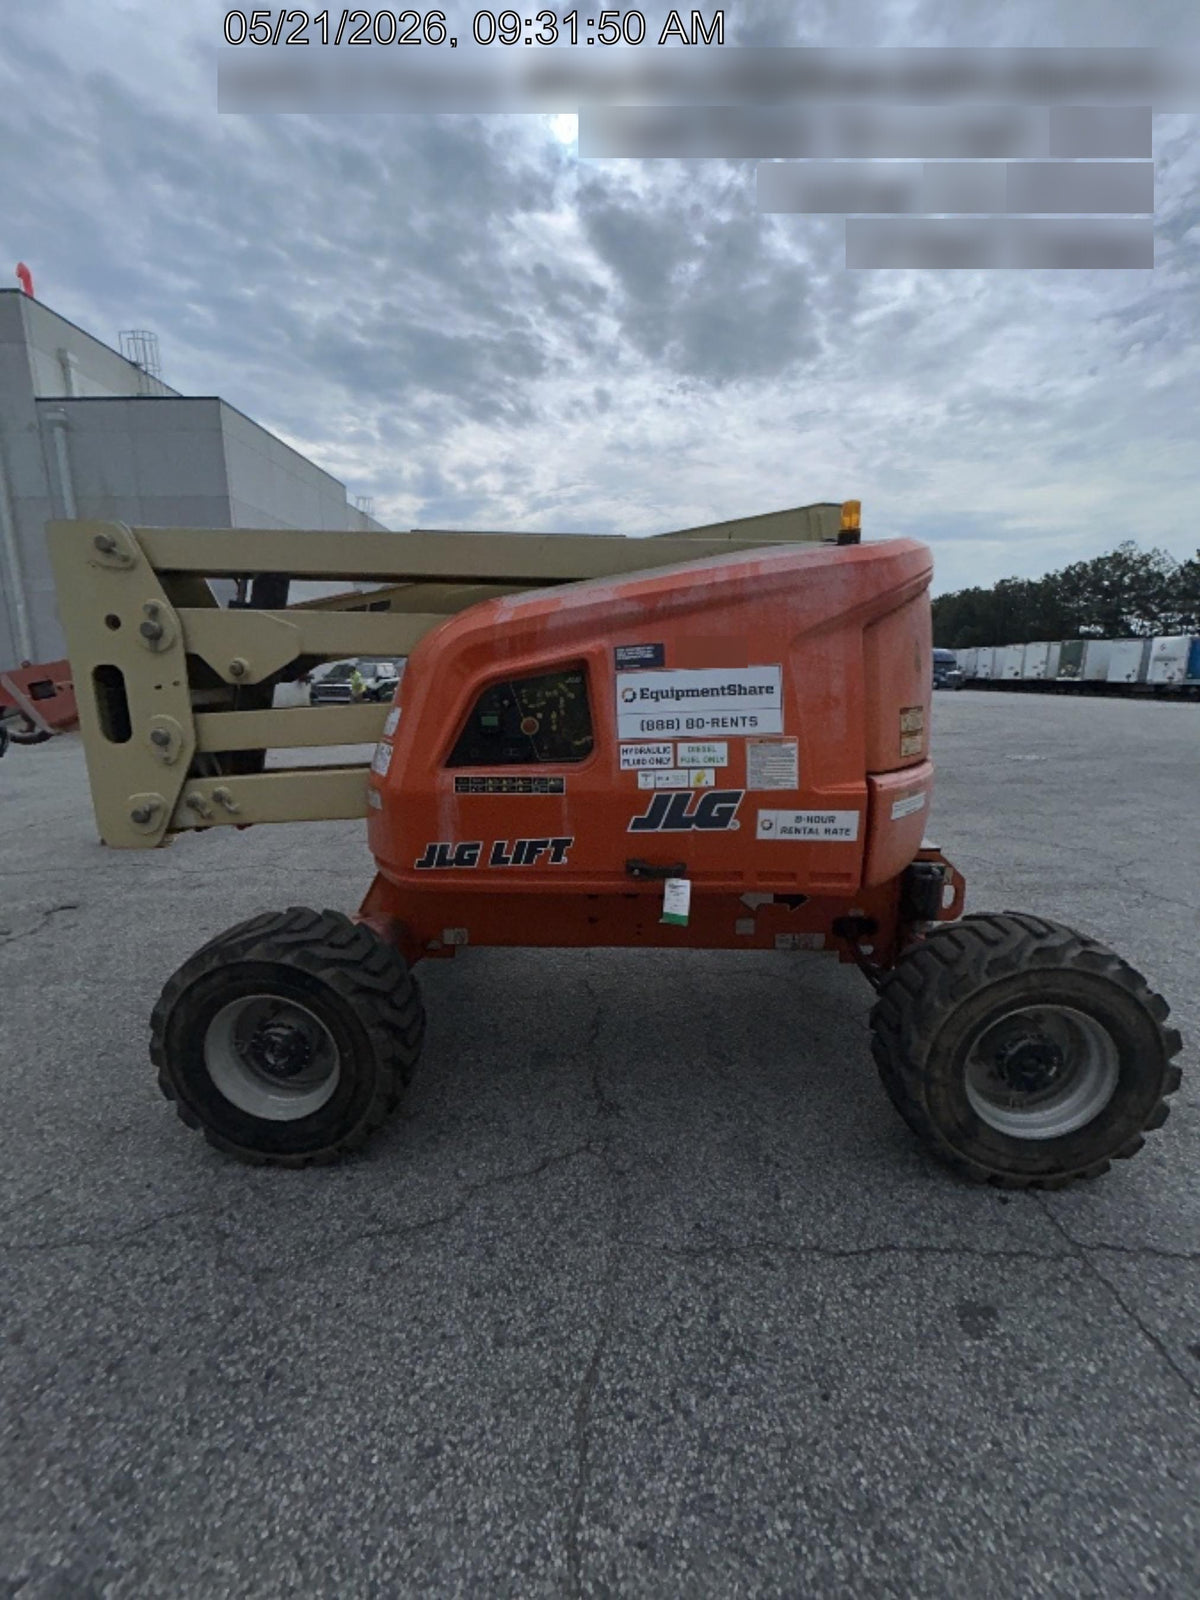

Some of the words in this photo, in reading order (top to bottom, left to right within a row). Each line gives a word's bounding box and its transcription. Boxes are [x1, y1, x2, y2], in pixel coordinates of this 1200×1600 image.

[640, 684, 774, 701] EquipmentShare
[640, 718, 680, 731] (888)
[686, 716, 758, 729] 80-RENTS
[622, 746, 671, 756] HYDRAULIC
[628, 790, 745, 832] JLG
[780, 826, 820, 835] RENTAL
[825, 828, 851, 836] RATE
[414, 841, 483, 869] JLG
[489, 837, 574, 868] LIFT
